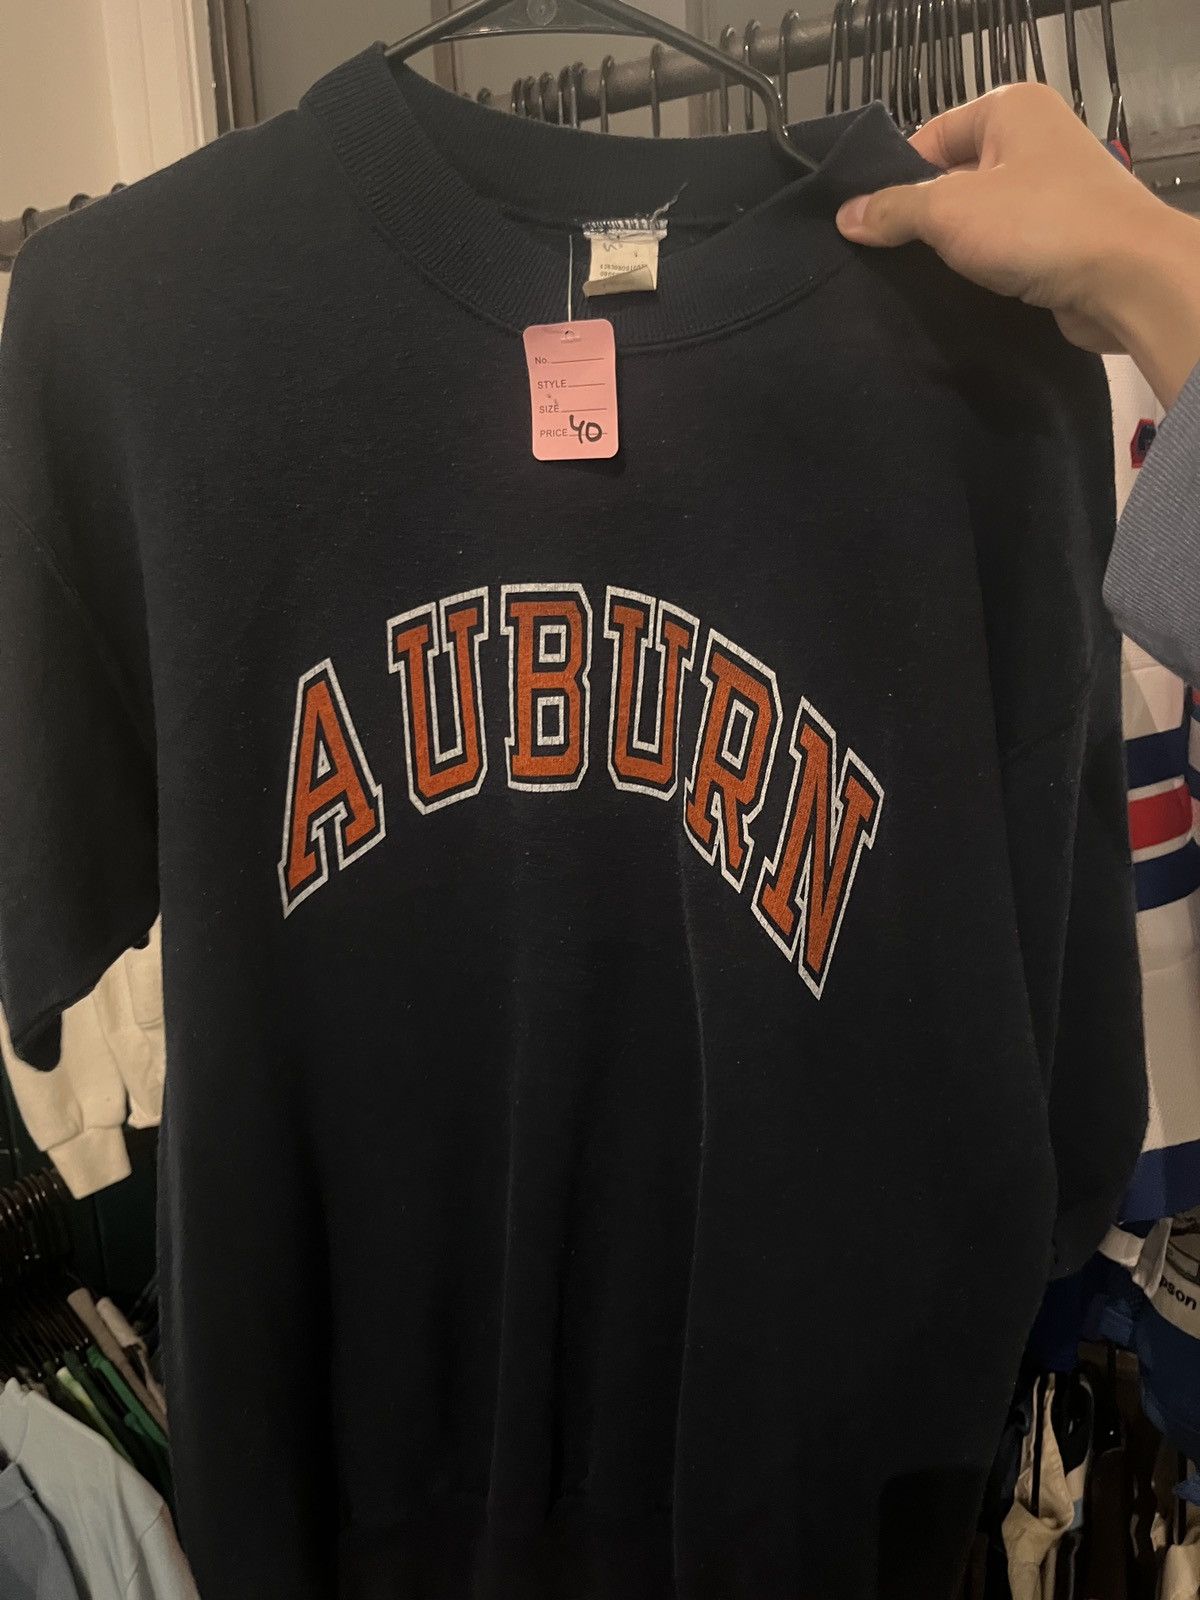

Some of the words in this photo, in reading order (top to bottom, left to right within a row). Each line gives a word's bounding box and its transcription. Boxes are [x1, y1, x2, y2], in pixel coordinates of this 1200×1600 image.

[537, 380, 567, 389] STYLE
[539, 404, 560, 413] SIZE
[540, 428, 568, 437] PRICE
[569, 414, 603, 444] 40
[277, 583, 885, 1000] AUBURN
